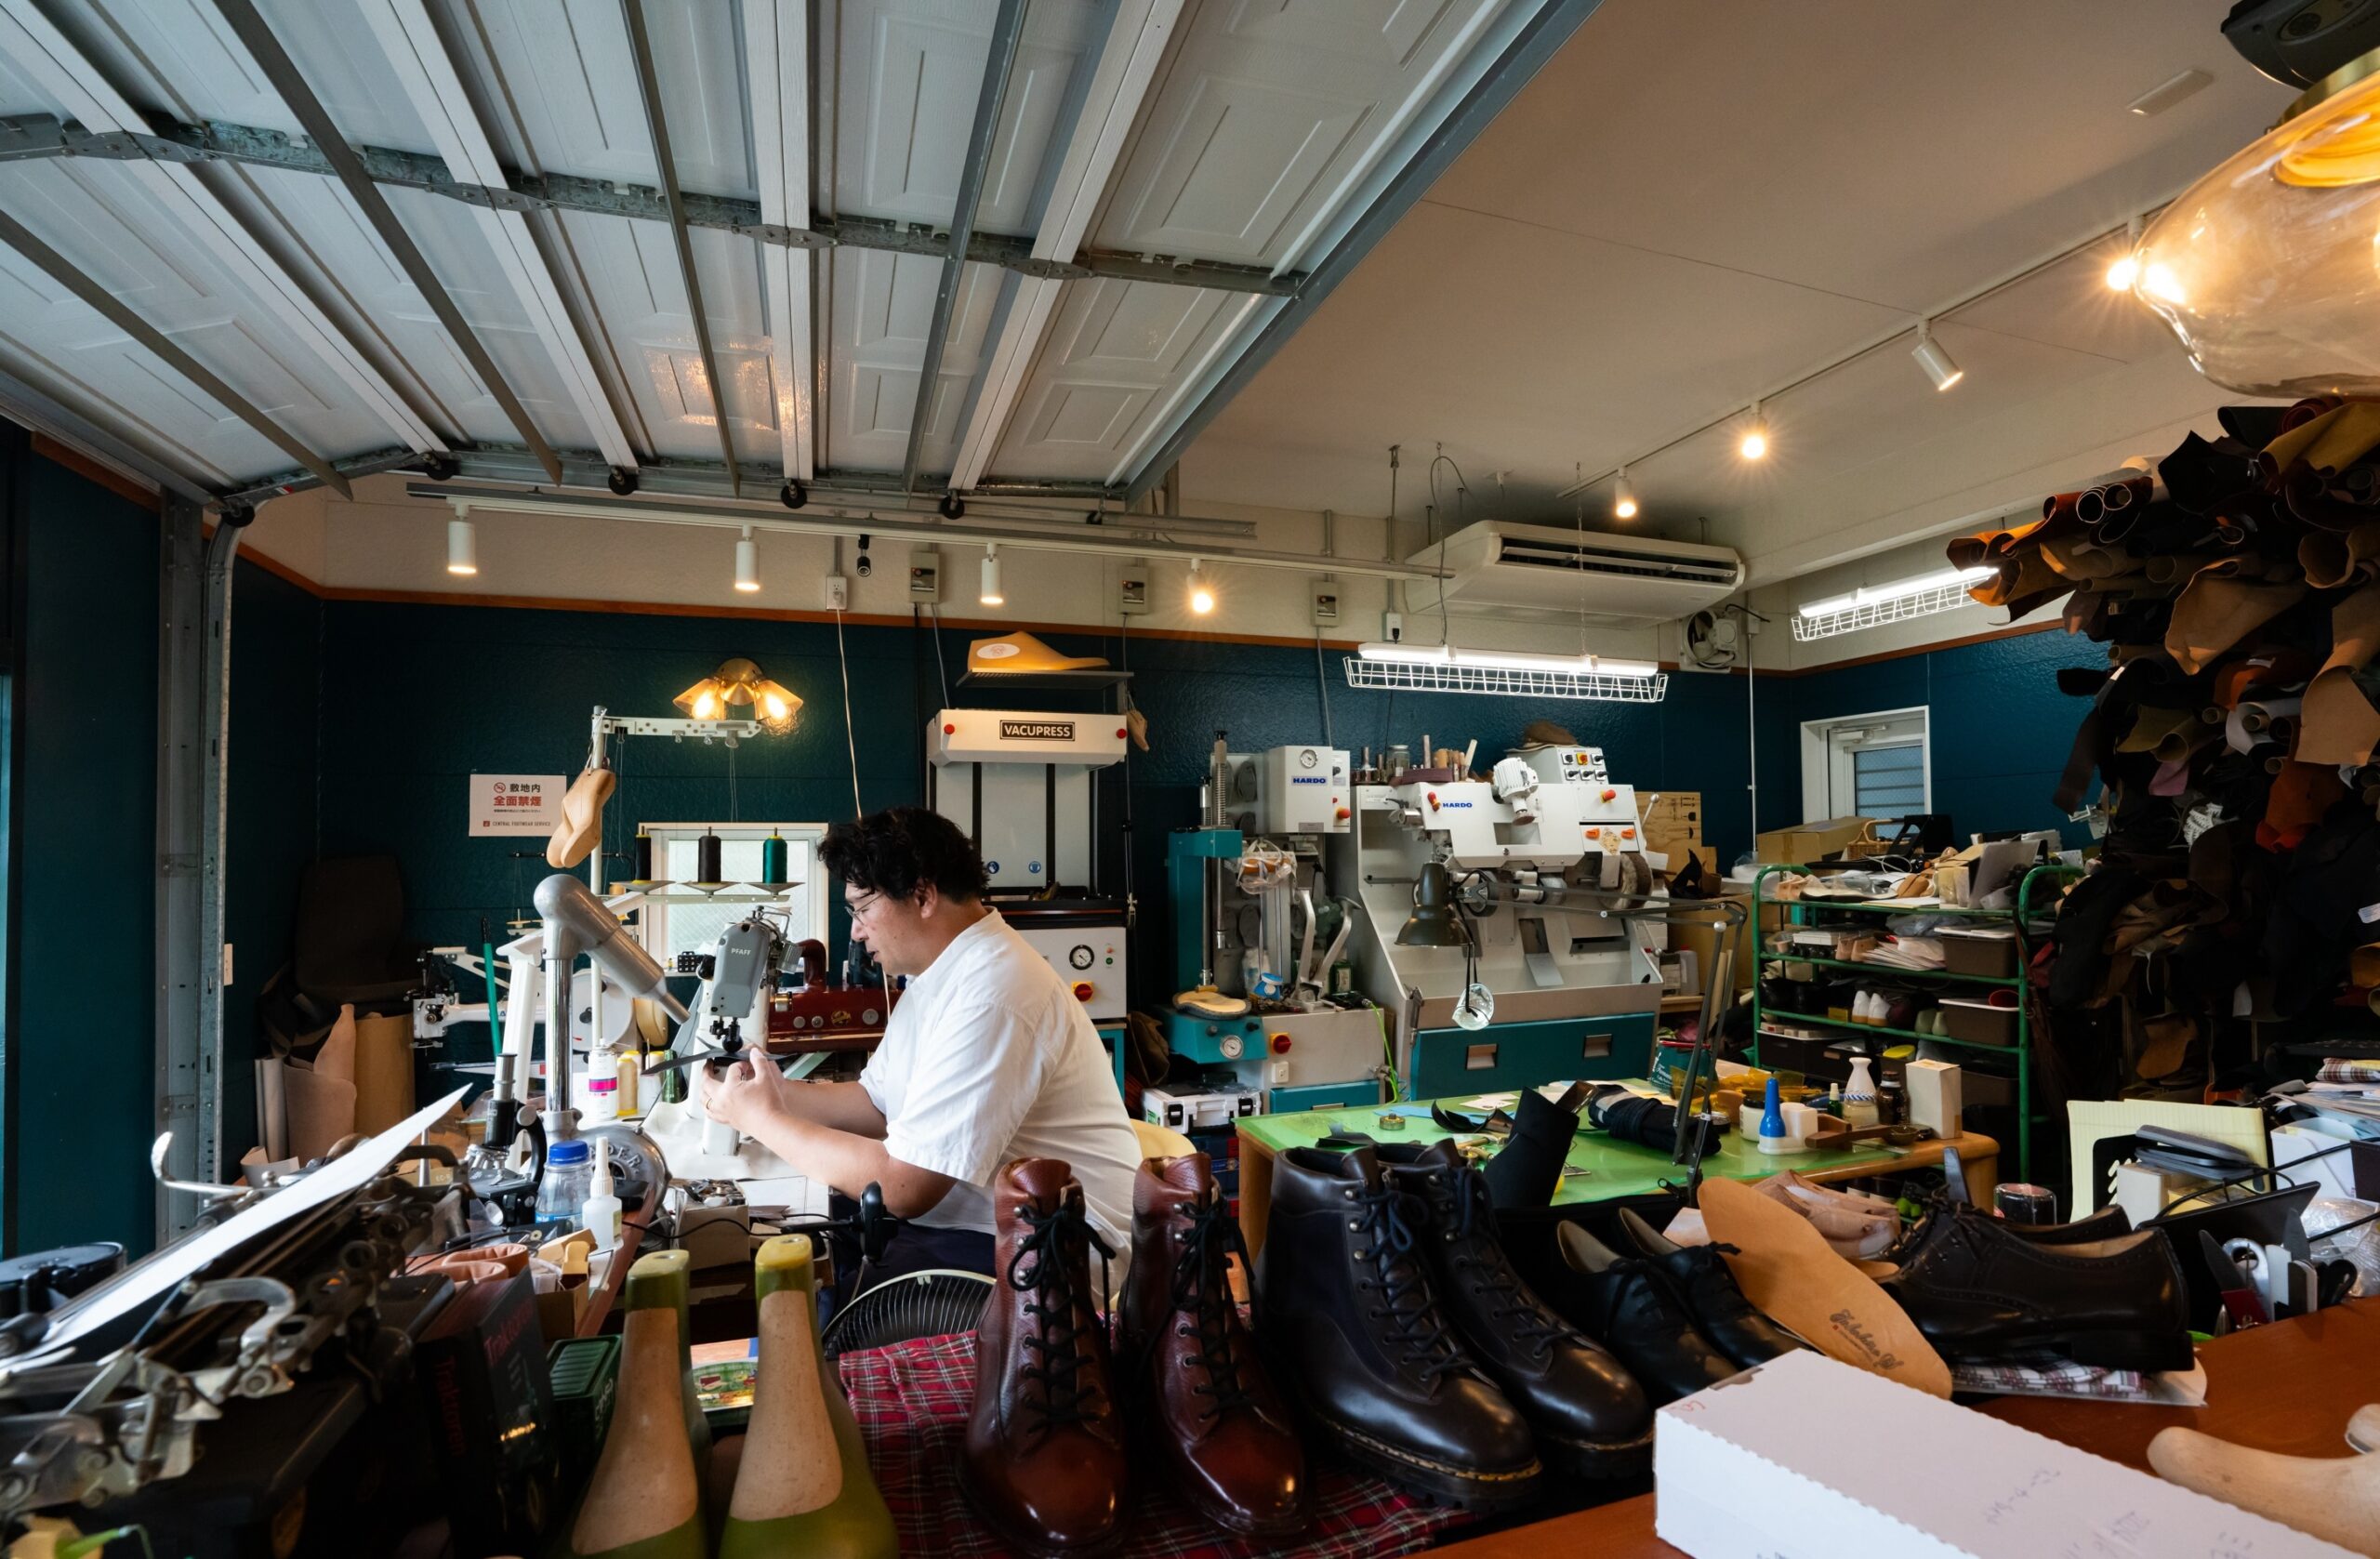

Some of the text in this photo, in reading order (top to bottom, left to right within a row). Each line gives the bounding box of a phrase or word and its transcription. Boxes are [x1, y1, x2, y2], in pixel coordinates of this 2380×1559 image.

[1004, 725, 1071, 737] VACUPRESS
[509, 783, 541, 793] 敷地内
[494, 796, 542, 806] 全面禁煙
